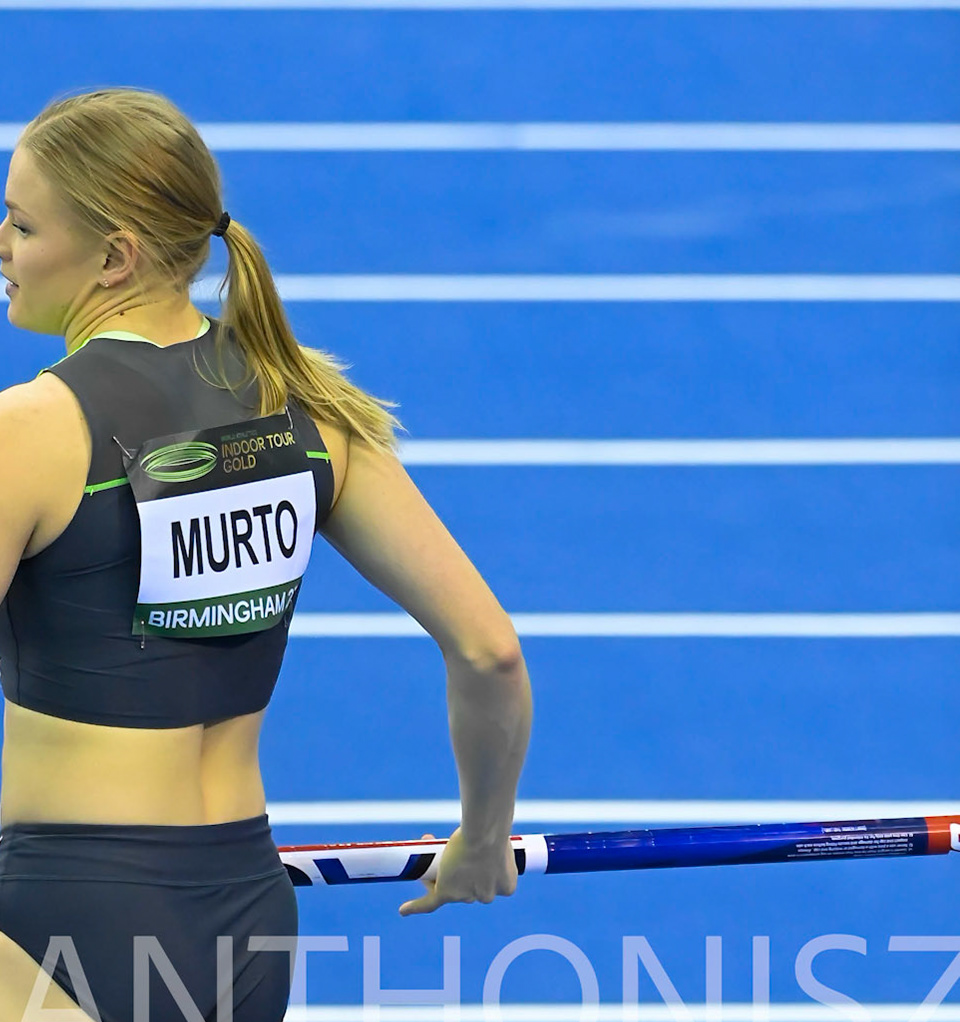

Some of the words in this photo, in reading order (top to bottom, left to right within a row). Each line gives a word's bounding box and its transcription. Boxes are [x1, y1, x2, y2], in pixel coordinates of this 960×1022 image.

[222, 437, 265, 458] INDOOR
[266, 432, 295, 448] TOUR
[223, 455, 256, 473] GOLD
[171, 500, 298, 578] MURTO
[148, 591, 286, 629] BIRMINGHAM
